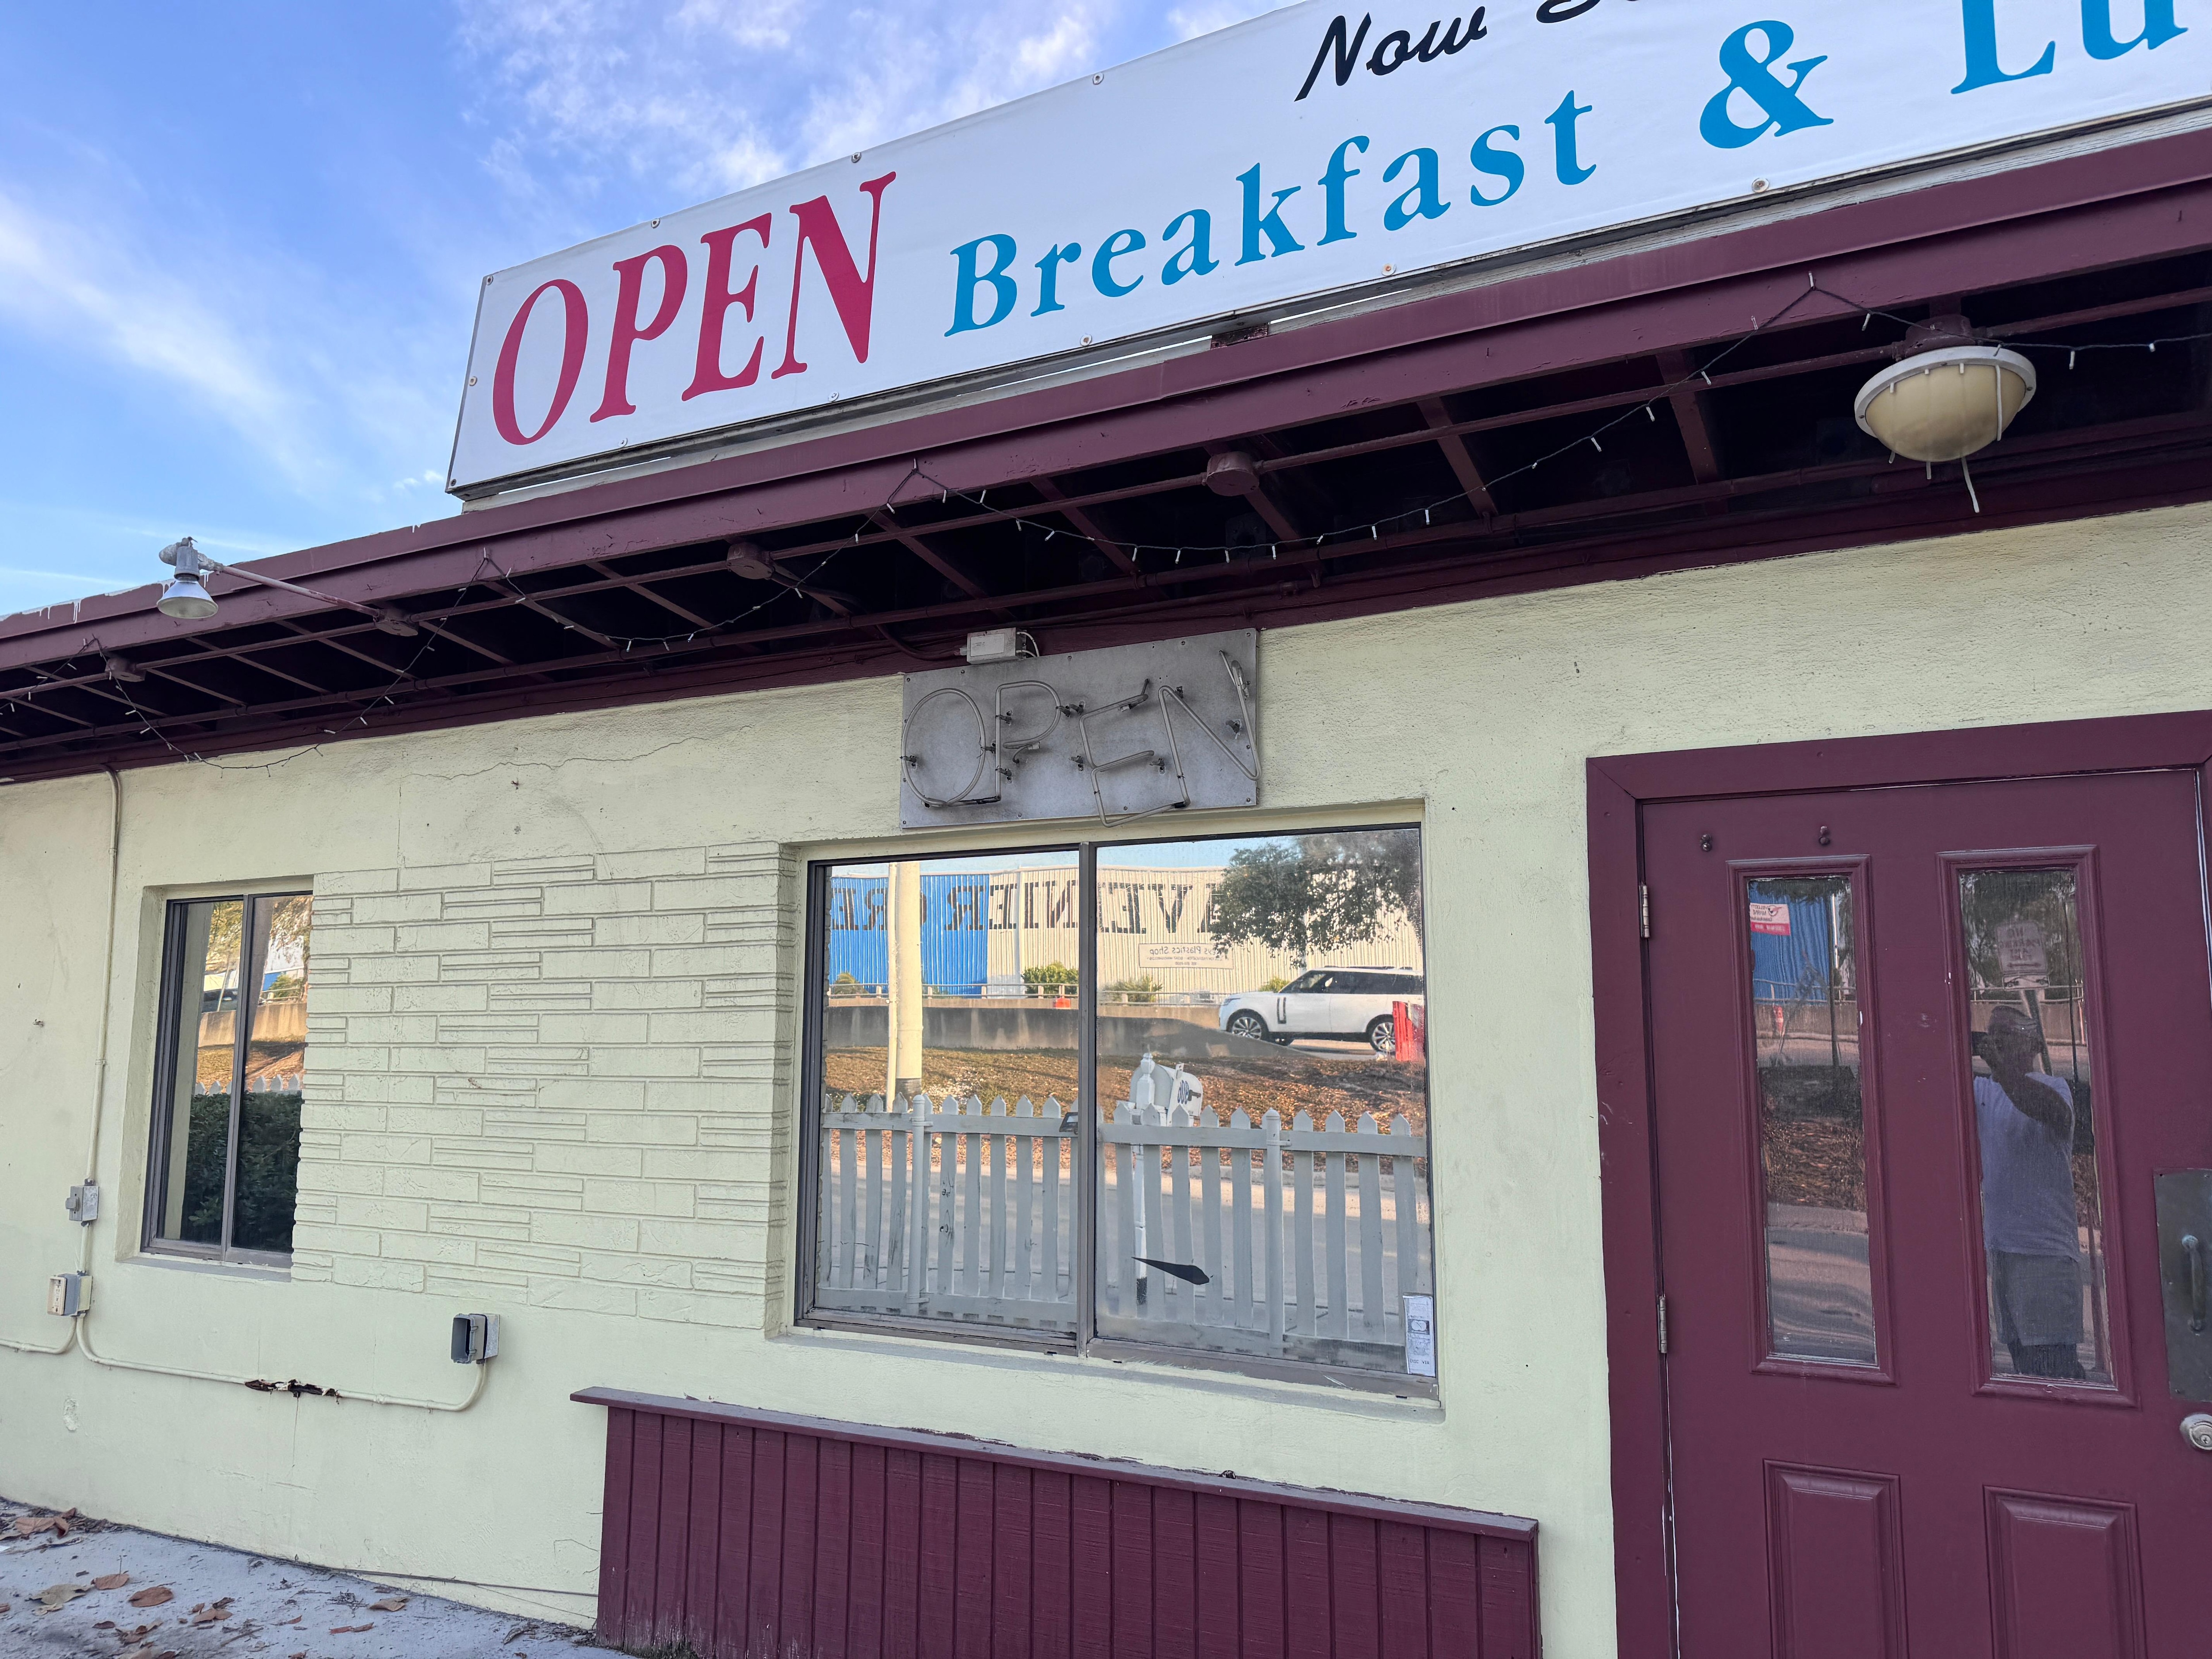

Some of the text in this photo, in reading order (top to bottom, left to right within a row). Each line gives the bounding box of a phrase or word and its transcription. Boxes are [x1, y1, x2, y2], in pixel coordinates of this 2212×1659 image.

[1294, 6, 1487, 102] Now
[492, 172, 896, 445] OPEN
[945, 89, 1596, 337] Breakfast
[1700, 20, 1833, 149] &
[901, 659, 1262, 827] OPEN
